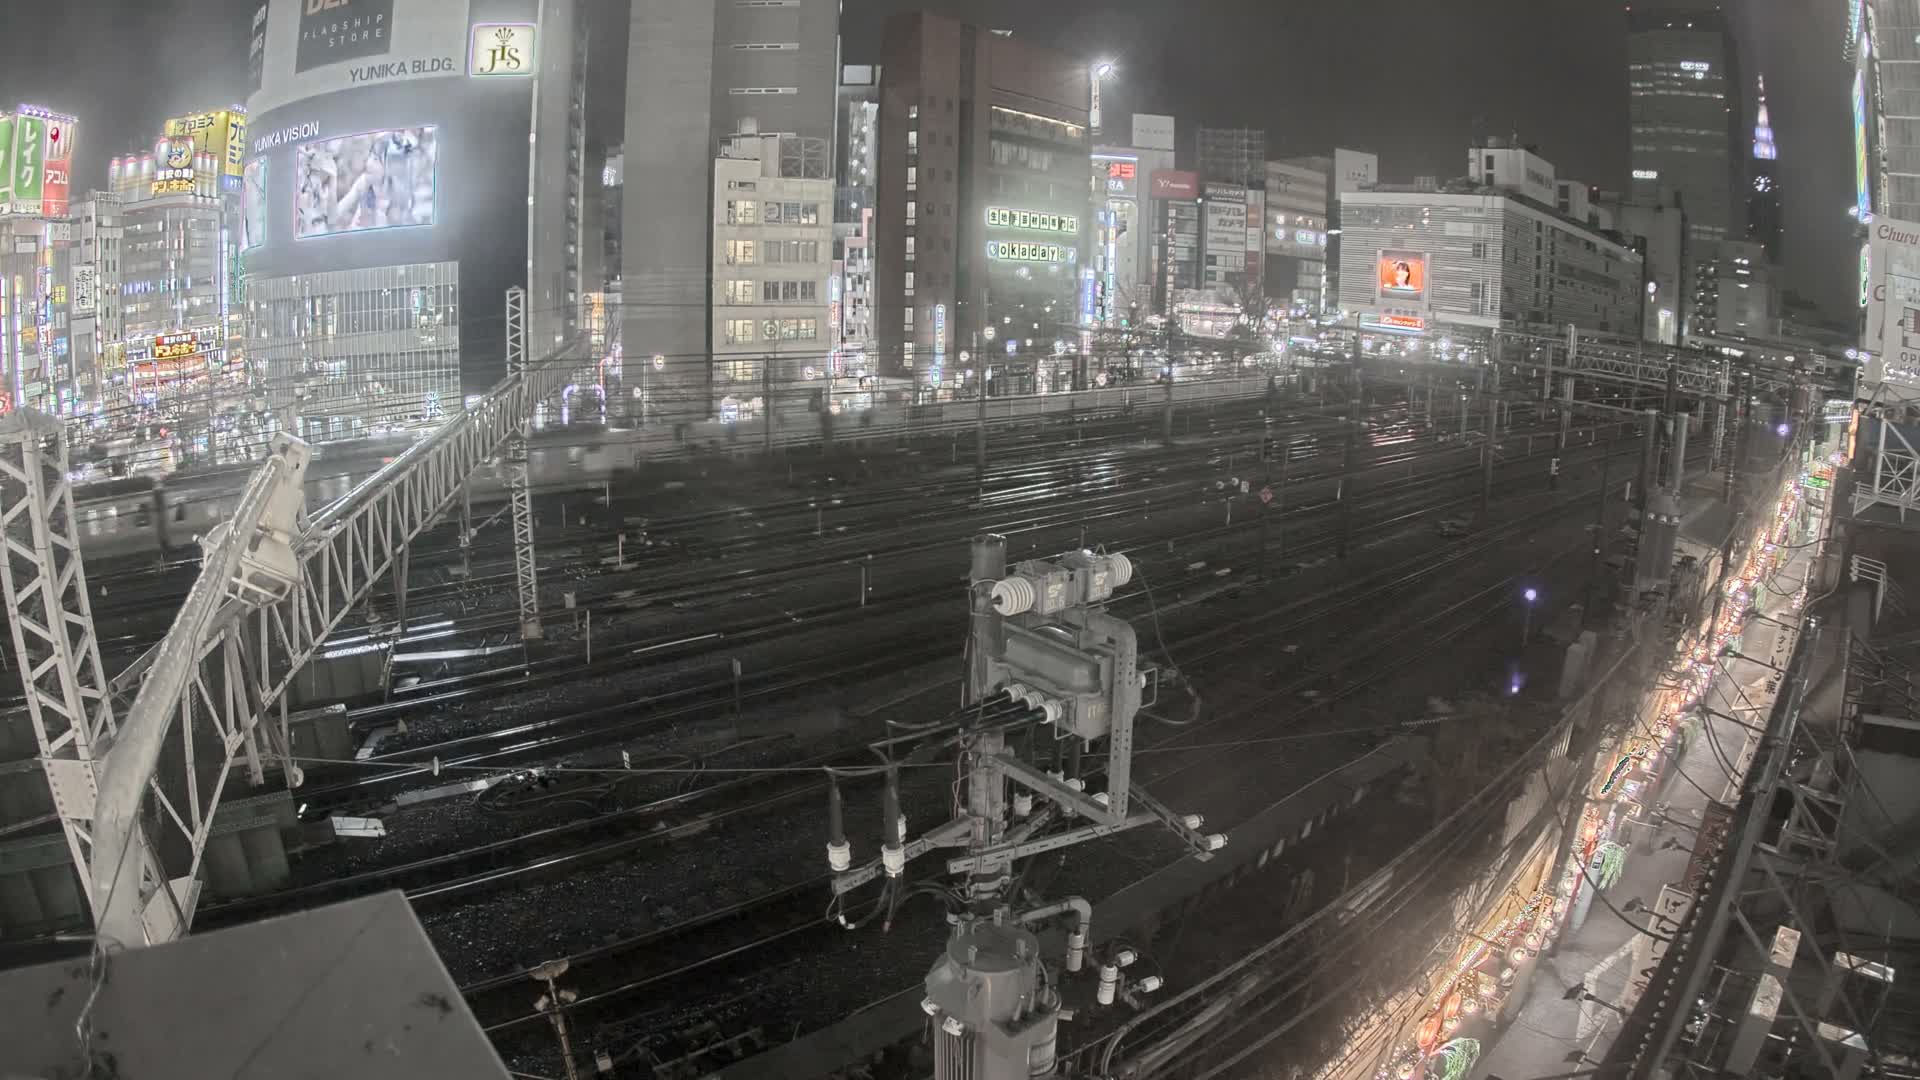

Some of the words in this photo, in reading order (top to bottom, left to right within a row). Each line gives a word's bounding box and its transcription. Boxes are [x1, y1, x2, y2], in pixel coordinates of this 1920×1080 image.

[304, 14, 383, 41] FLAGSHIP
[328, 28, 382, 48] STORE
[350, 61, 408, 82] YUNIKA
[411, 58, 456, 74] BLDG.
[254, 131, 281, 153] YUNIKA
[282, 120, 320, 143] VISION
[21, 121, 37, 188] レイク
[45, 169, 69, 185] アコム
[1000, 243, 1065, 261] okadaya
